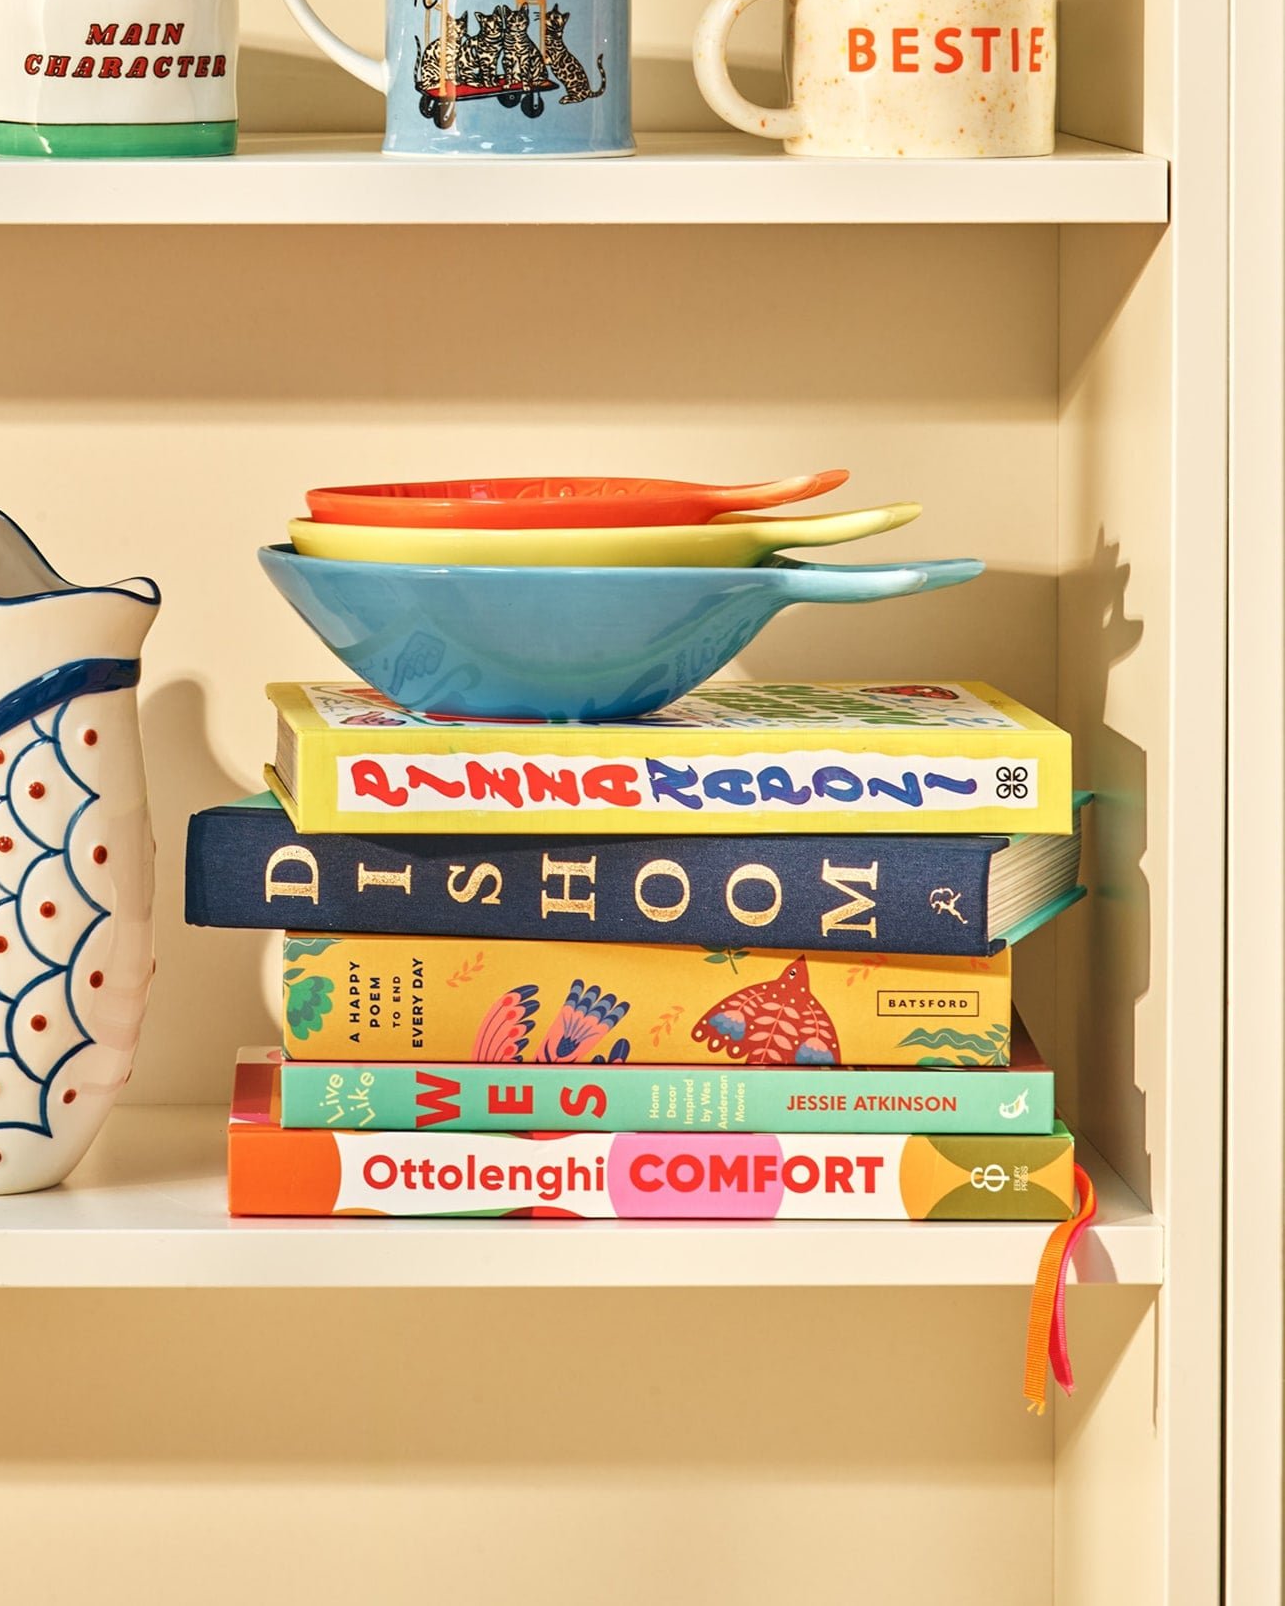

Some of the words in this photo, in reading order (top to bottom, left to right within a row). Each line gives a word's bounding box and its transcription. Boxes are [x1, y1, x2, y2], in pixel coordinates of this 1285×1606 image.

[85, 23, 185, 46] MAIN
[848, 27, 1045, 74] BESTIE
[24, 54, 227, 78] CHARACTER
[350, 759, 642, 808] PIZZA
[645, 757, 977, 810] NAPOLI
[264, 844, 879, 940] DISHOOM
[349, 961, 360, 1023] HAPPY
[392, 976, 401, 1002] END
[412, 958, 423, 989] DAY
[369, 977, 381, 1028] POEM
[392, 1011, 401, 1028] TO
[412, 995, 423, 1048] EVERY
[888, 999, 968, 1009] BATSFORD
[349, 1032, 360, 1043] A
[319, 1073, 345, 1124] Live
[347, 1072, 376, 1127] Like
[415, 1070, 608, 1129] WES
[649, 1084, 660, 1119] Home
[666, 1084, 677, 1118] Decor
[683, 1079, 696, 1125] Inspired
[700, 1081, 712, 1106] Wes
[717, 1075, 729, 1130] Anderson
[734, 1082, 746, 1122] Movies
[787, 1095, 847, 1112] JESSIE
[853, 1096, 958, 1112] ATKINSON
[700, 1107, 713, 1123] by
[362, 1154, 604, 1201] Ottolenghi
[629, 1153, 884, 1194] COMFORT
